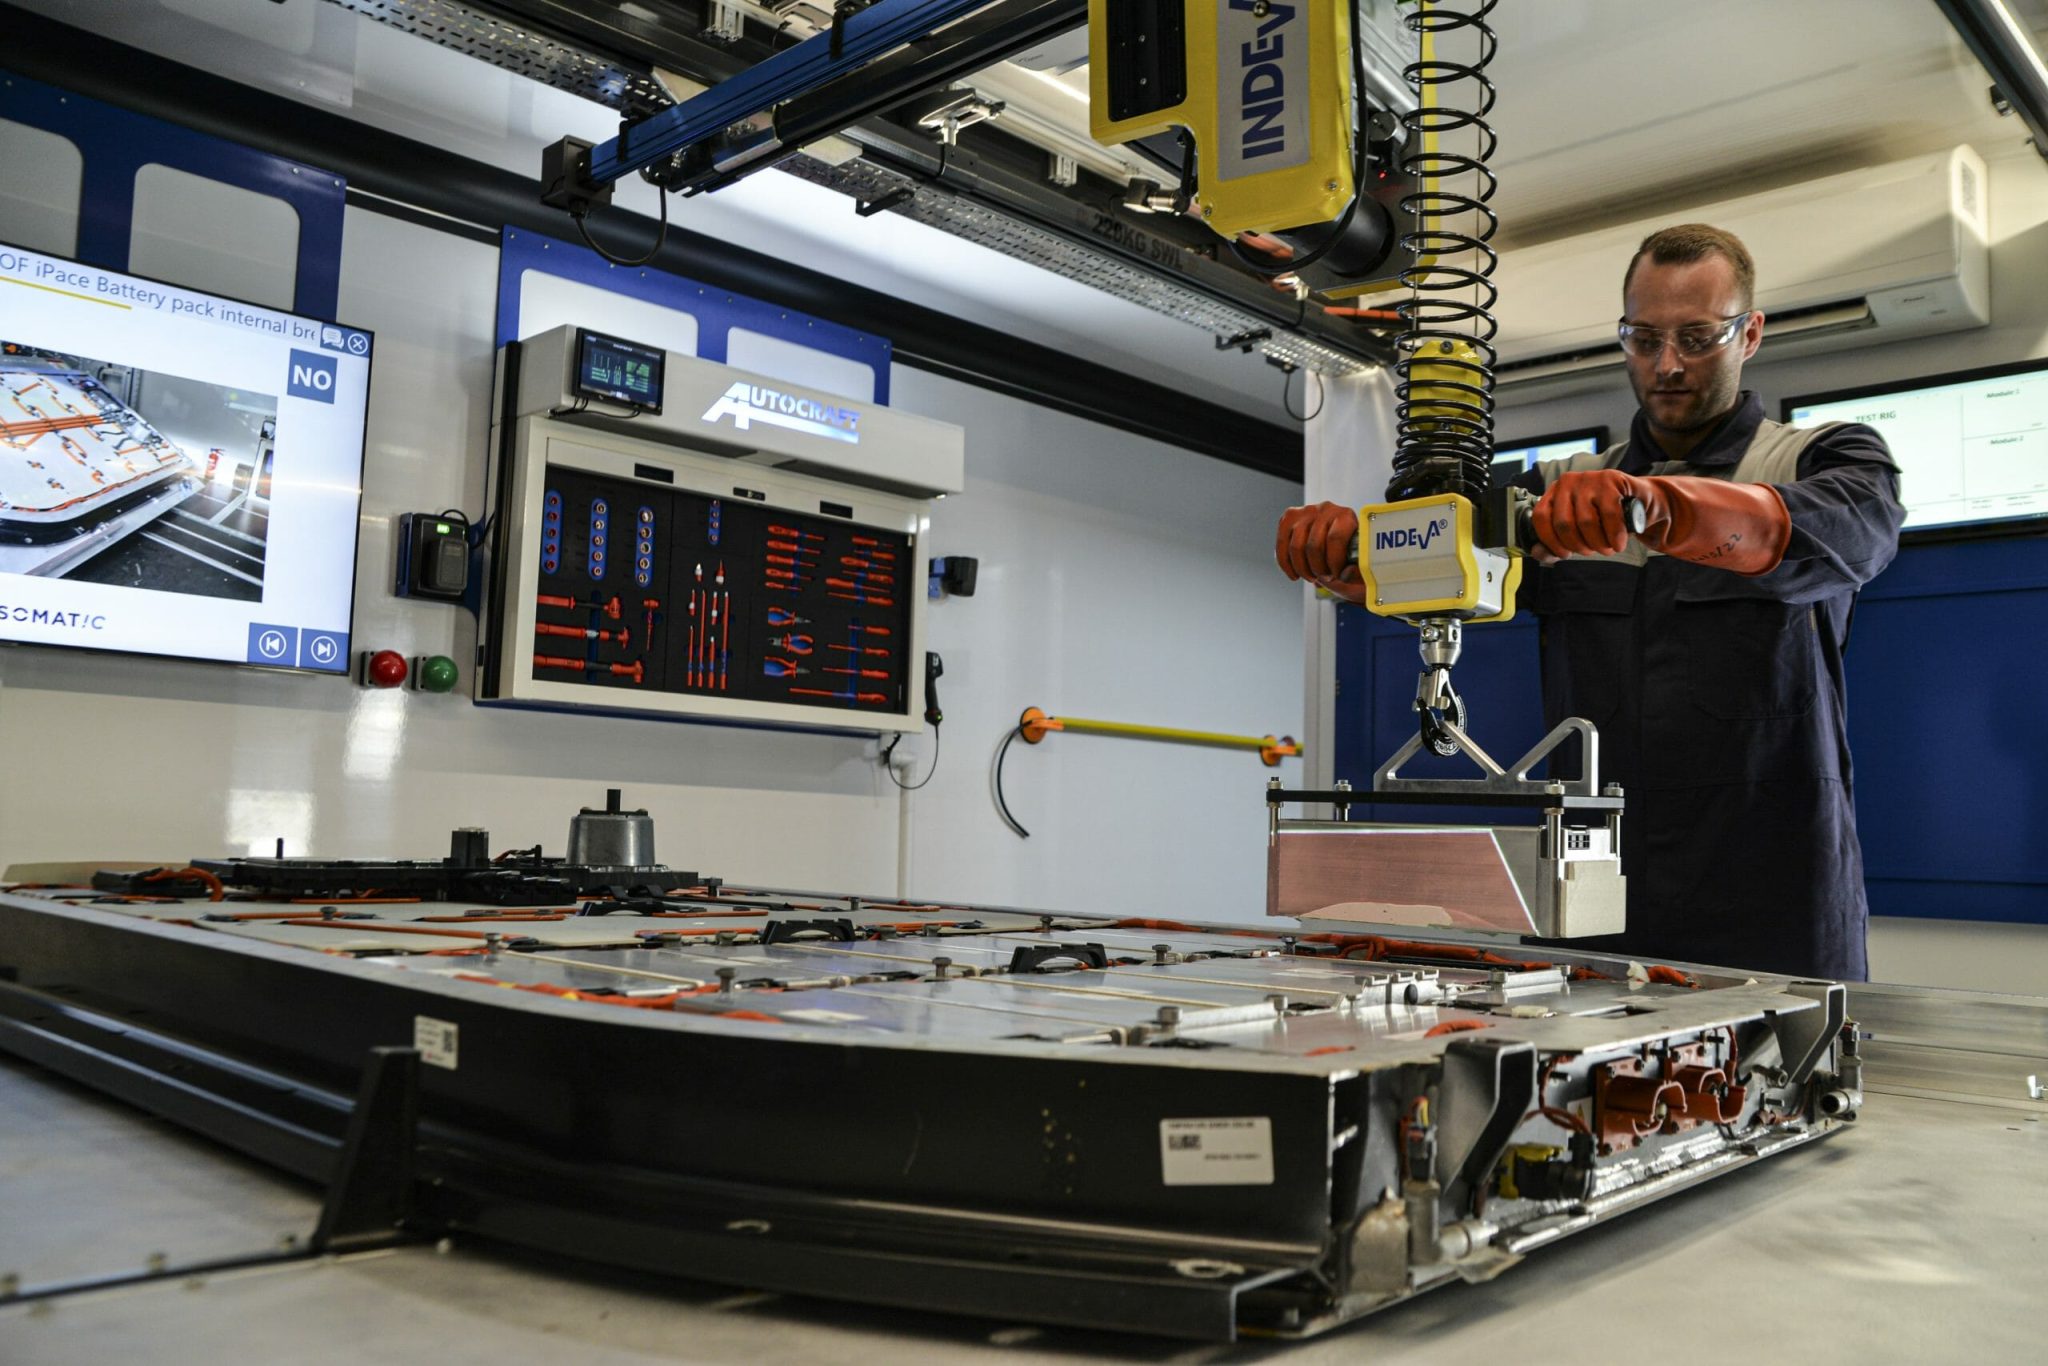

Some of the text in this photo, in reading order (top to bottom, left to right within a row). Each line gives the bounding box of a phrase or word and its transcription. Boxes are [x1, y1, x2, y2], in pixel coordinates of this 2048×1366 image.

[36, 261, 90, 288] iPace
[97, 276, 167, 310] Battery
[171, 297, 214, 319] pack
[220, 304, 287, 334] internal
[292, 365, 332, 391] NO
[701, 381, 861, 431] AUTOCRAFT
[1856, 410, 1897, 424] TEST RIG
